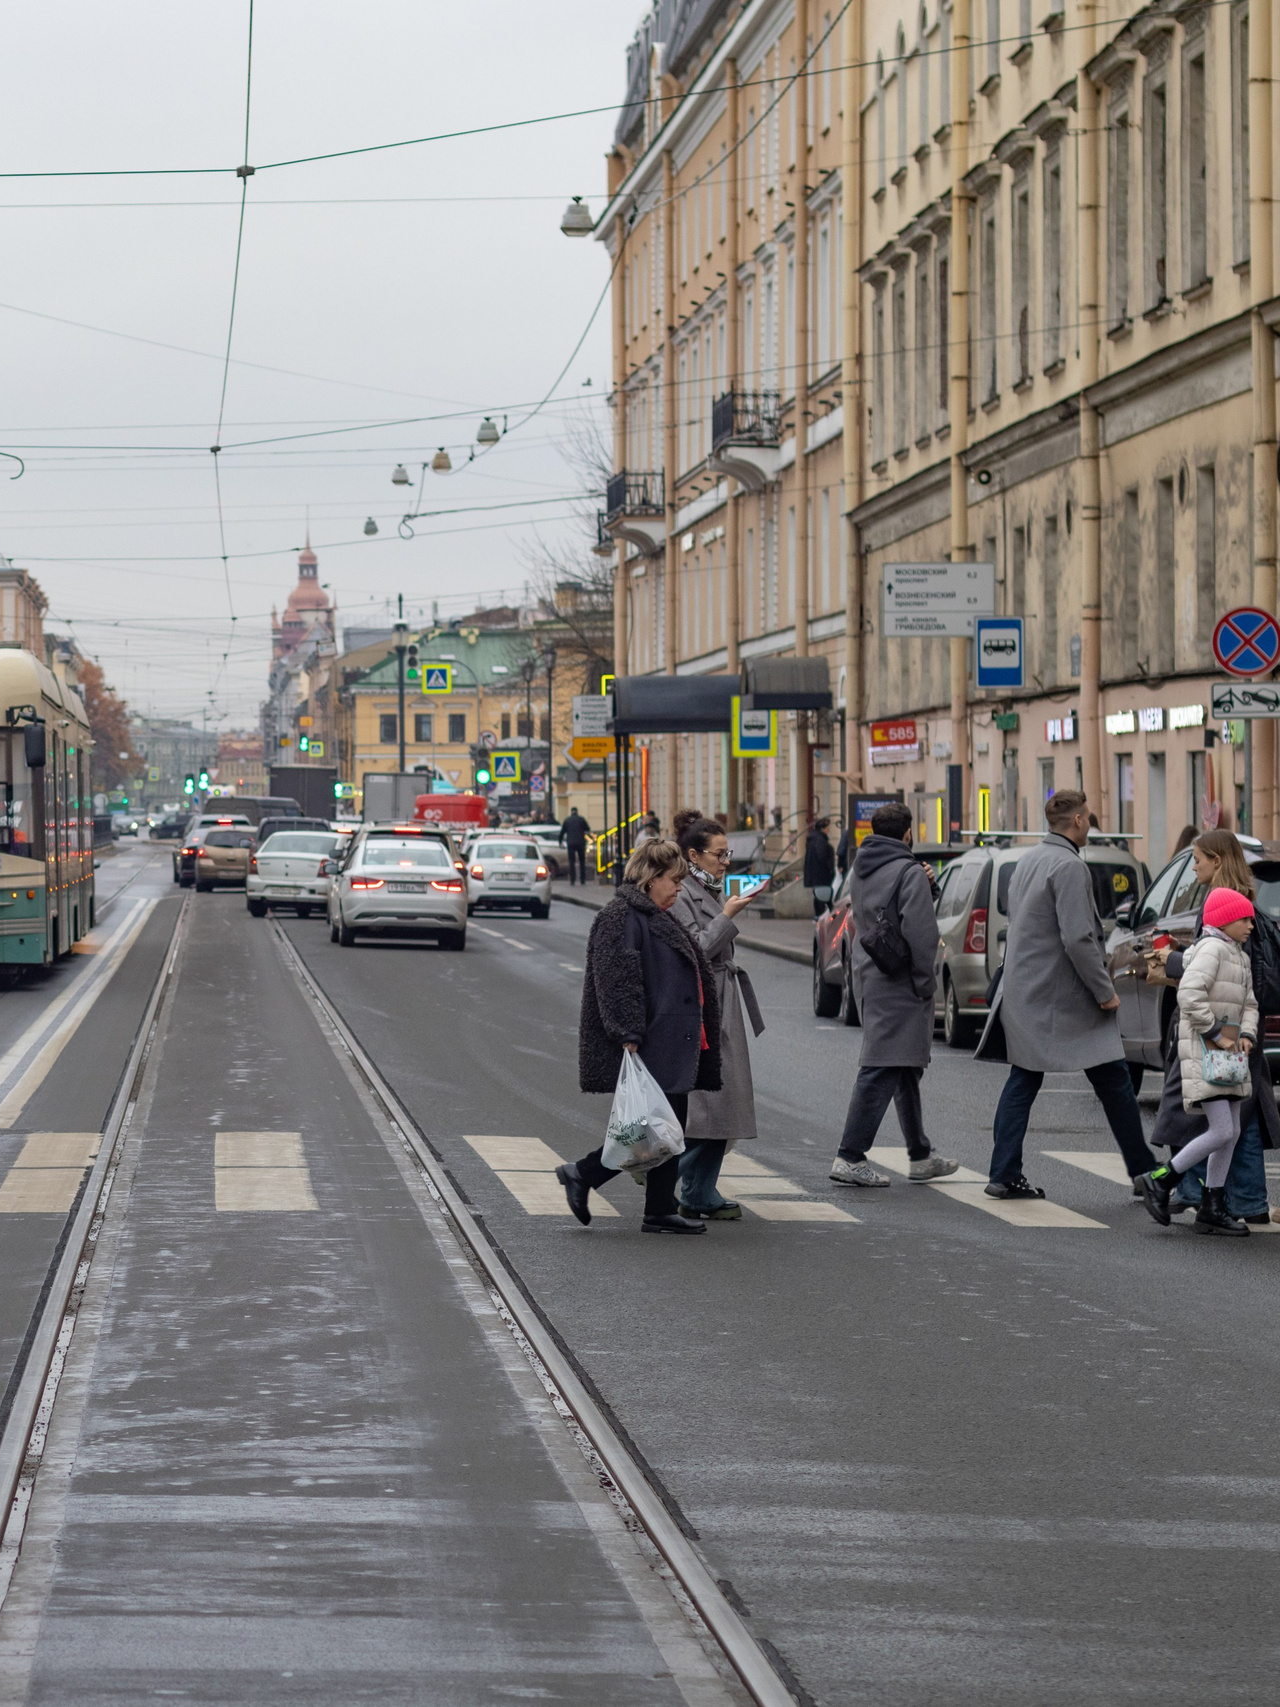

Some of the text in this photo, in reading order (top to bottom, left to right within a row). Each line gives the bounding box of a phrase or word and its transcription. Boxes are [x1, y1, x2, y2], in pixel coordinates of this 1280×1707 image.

[895, 568, 948, 576] МОСКОВСКИЙ
[895, 590, 956, 599] ВОЗНЕСЕНСКИЙ
[895, 623, 946, 631] ГРИБОЕДОВА
[888, 726, 915, 741] 585
